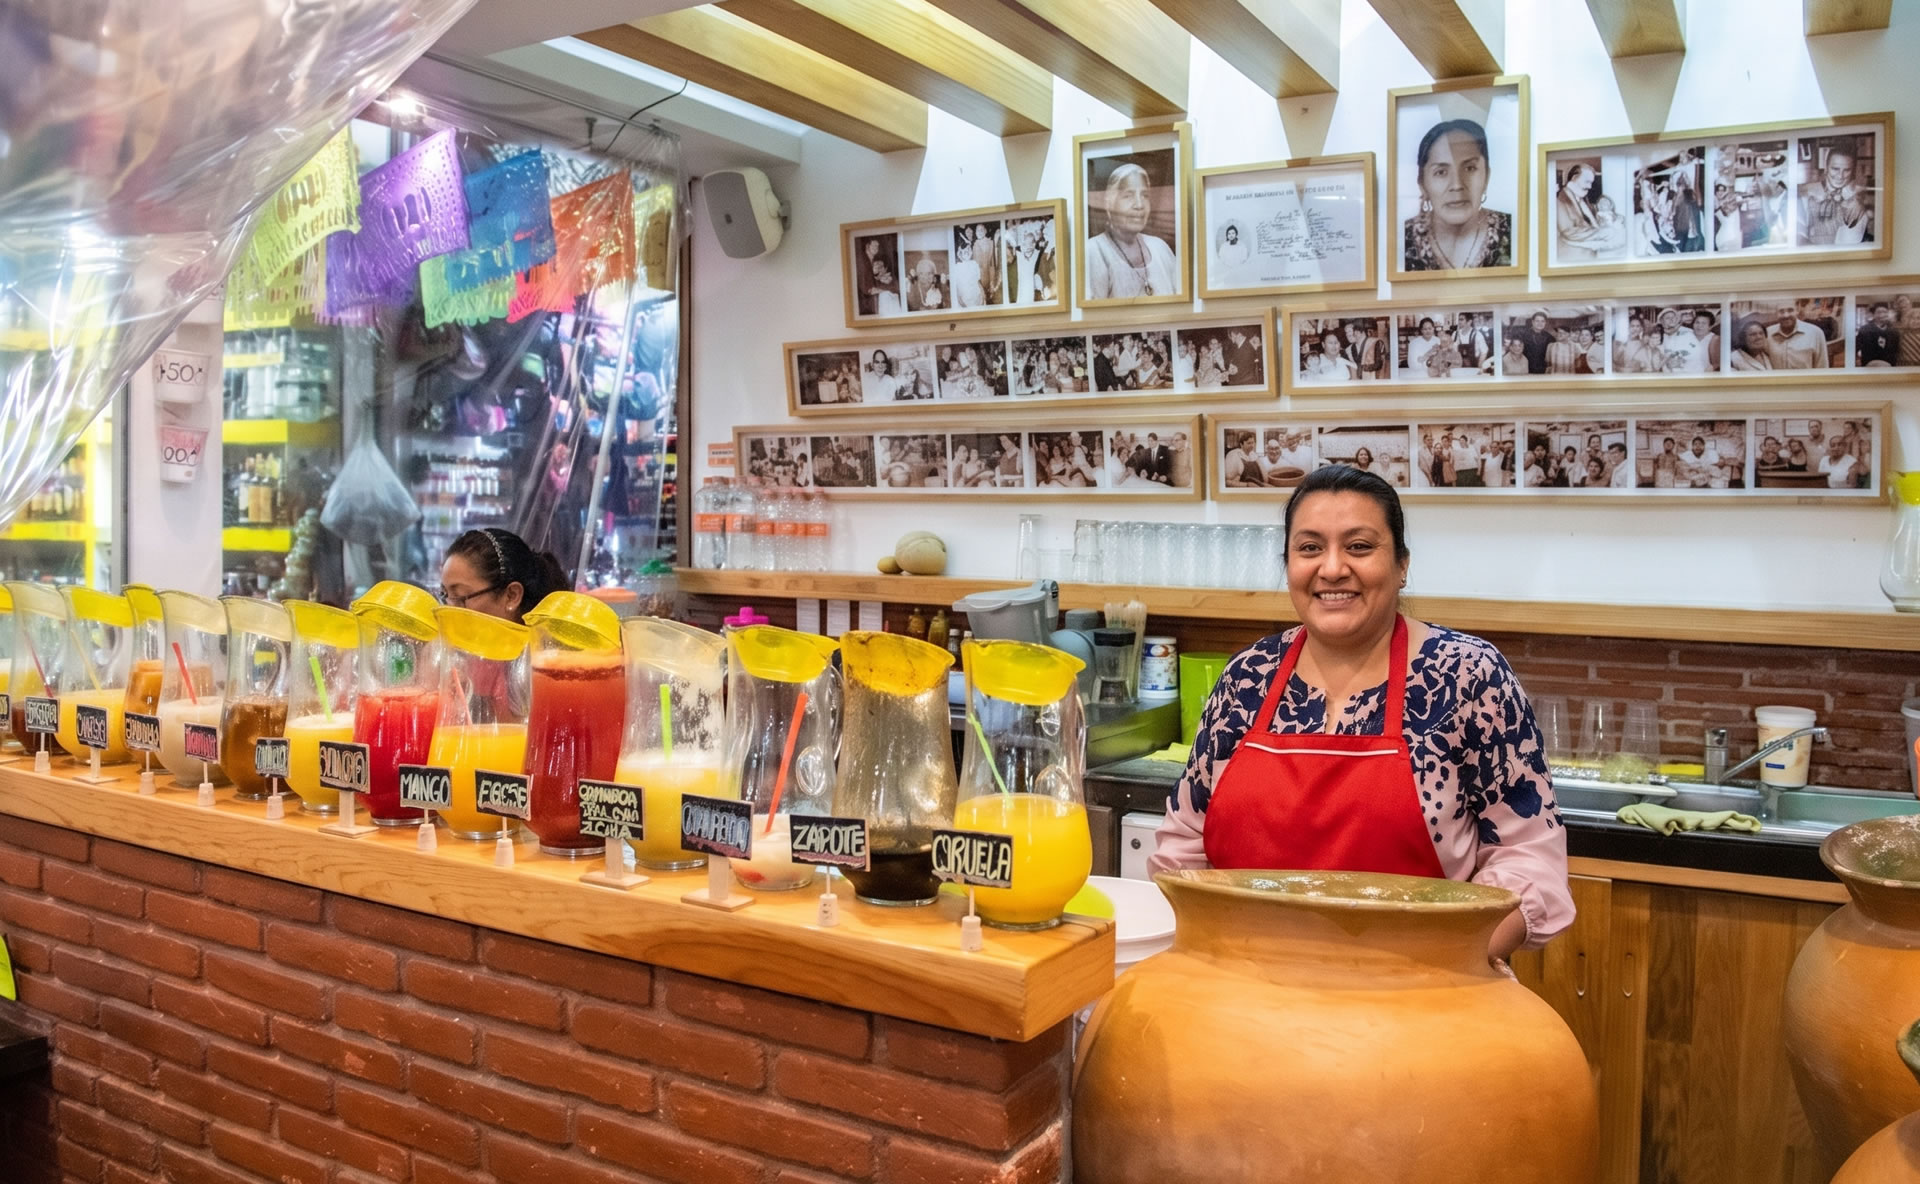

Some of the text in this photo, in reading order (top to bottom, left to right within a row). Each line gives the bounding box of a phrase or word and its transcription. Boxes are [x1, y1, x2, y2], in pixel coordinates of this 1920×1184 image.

[400, 773, 450, 804] MANGO
[793, 824, 866, 857] ZAPOTE
[932, 834, 1011, 880] CIRUELA
